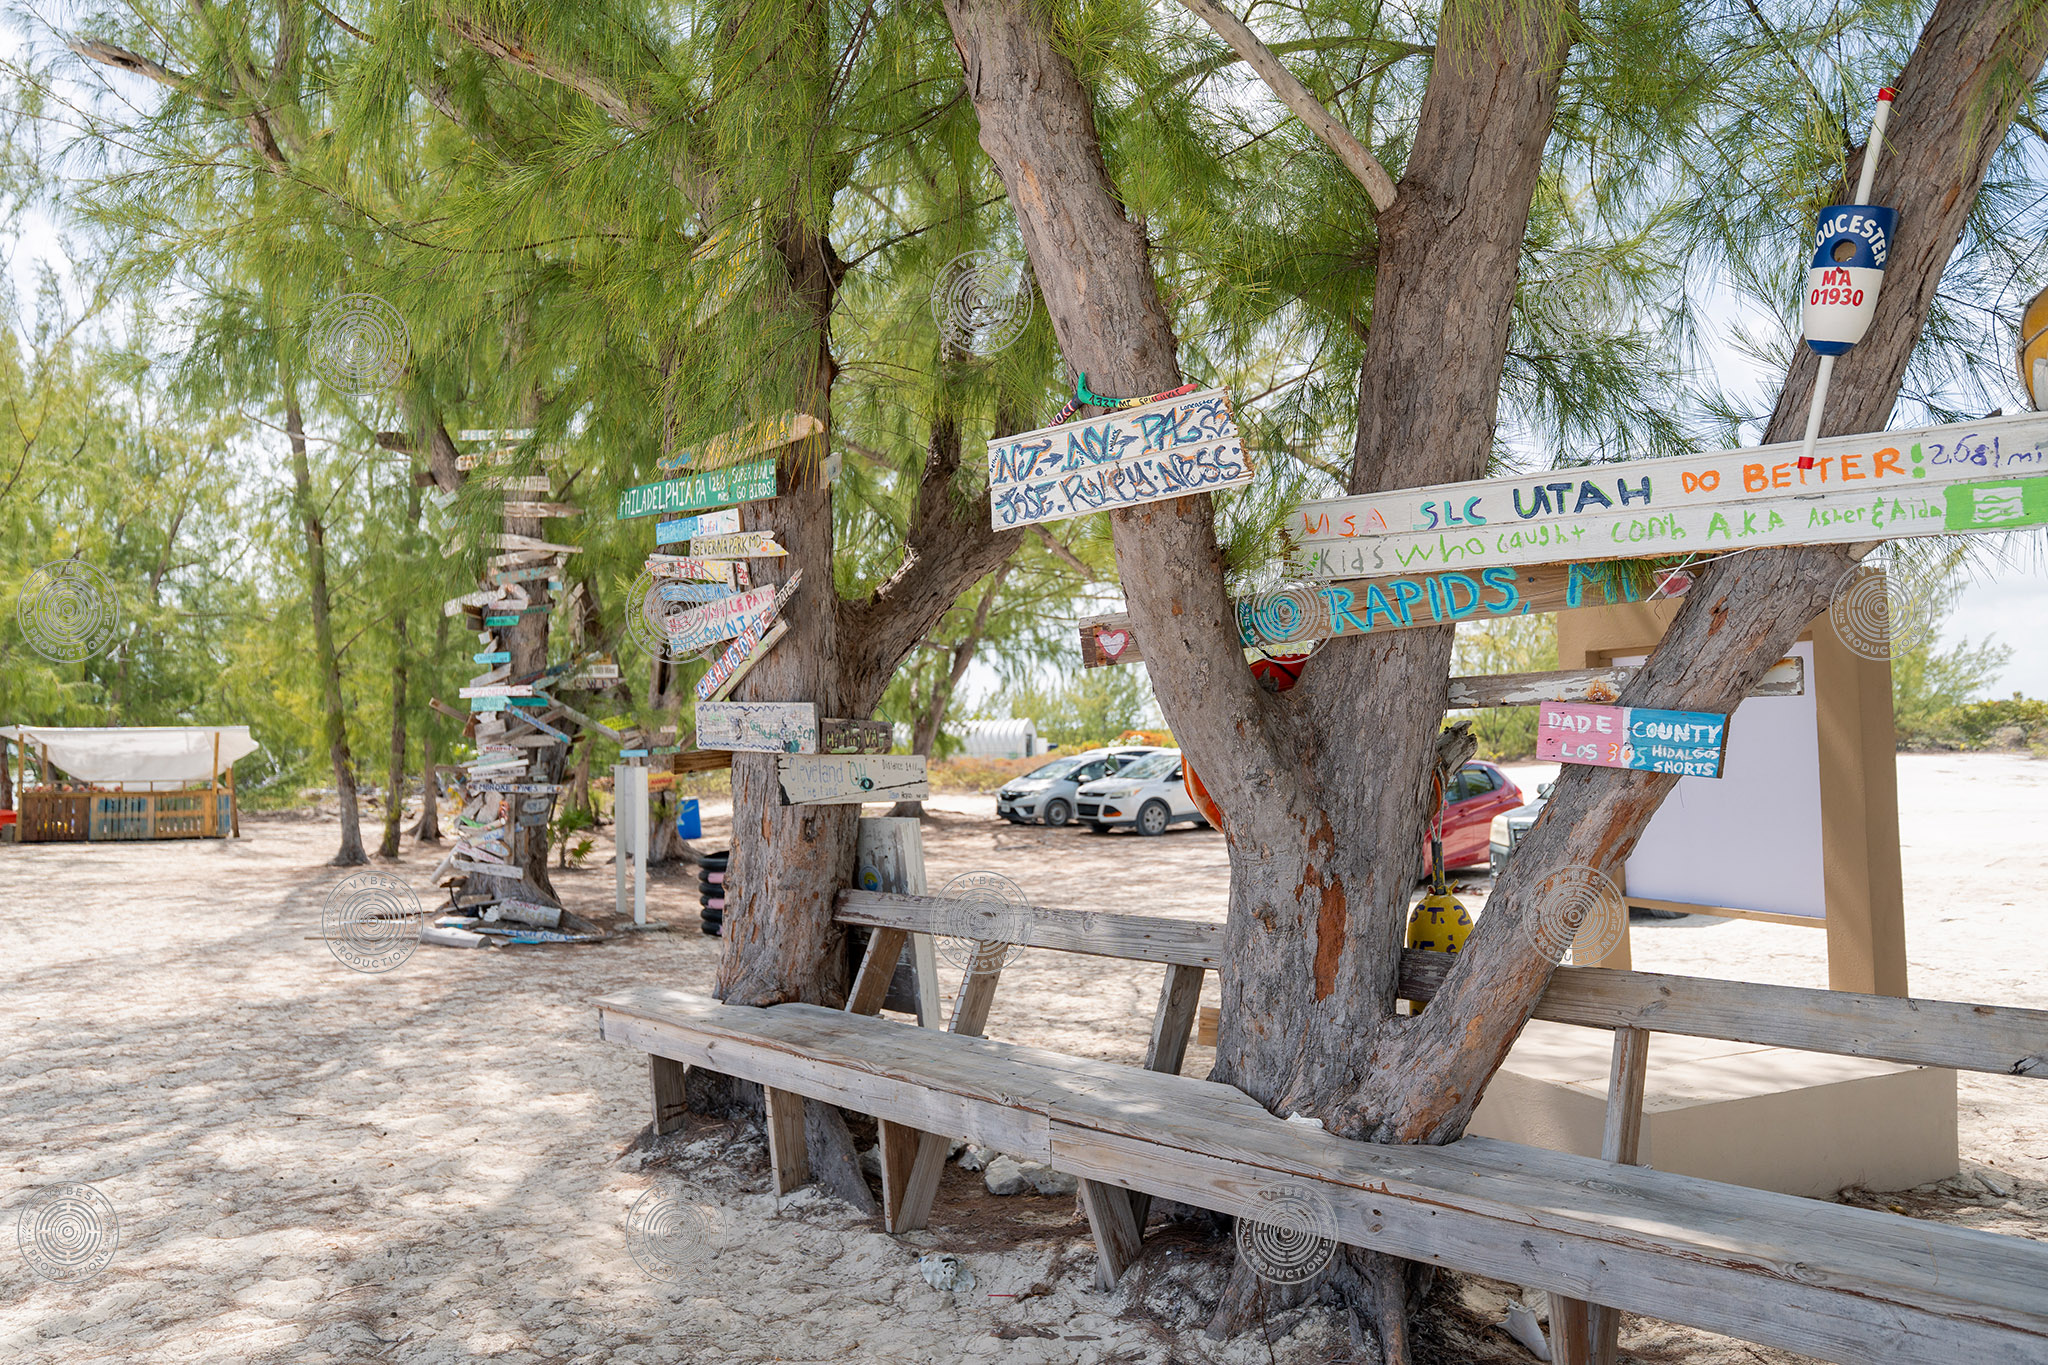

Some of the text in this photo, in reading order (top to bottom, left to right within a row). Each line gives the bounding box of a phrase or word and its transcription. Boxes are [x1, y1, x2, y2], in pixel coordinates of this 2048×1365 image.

[1822, 270, 1852, 287] MA
[1811, 289, 1864, 307] 01930
[736, 486, 747, 499] GO
[1413, 496, 1487, 530] SLC
[1513, 476, 1653, 519] UTAH
[1682, 470, 1720, 494] DO
[692, 534, 762, 557] SEVERNA PARK MD
[726, 615, 747, 637] NJ
[697, 628, 757, 700] WASHINGTON
[1548, 712, 1723, 744] DADE COUNTY
[1561, 742, 1646, 767] LOS 305
[789, 757, 844, 784] Cleveland
[1653, 760, 1716, 777] SHORTS
